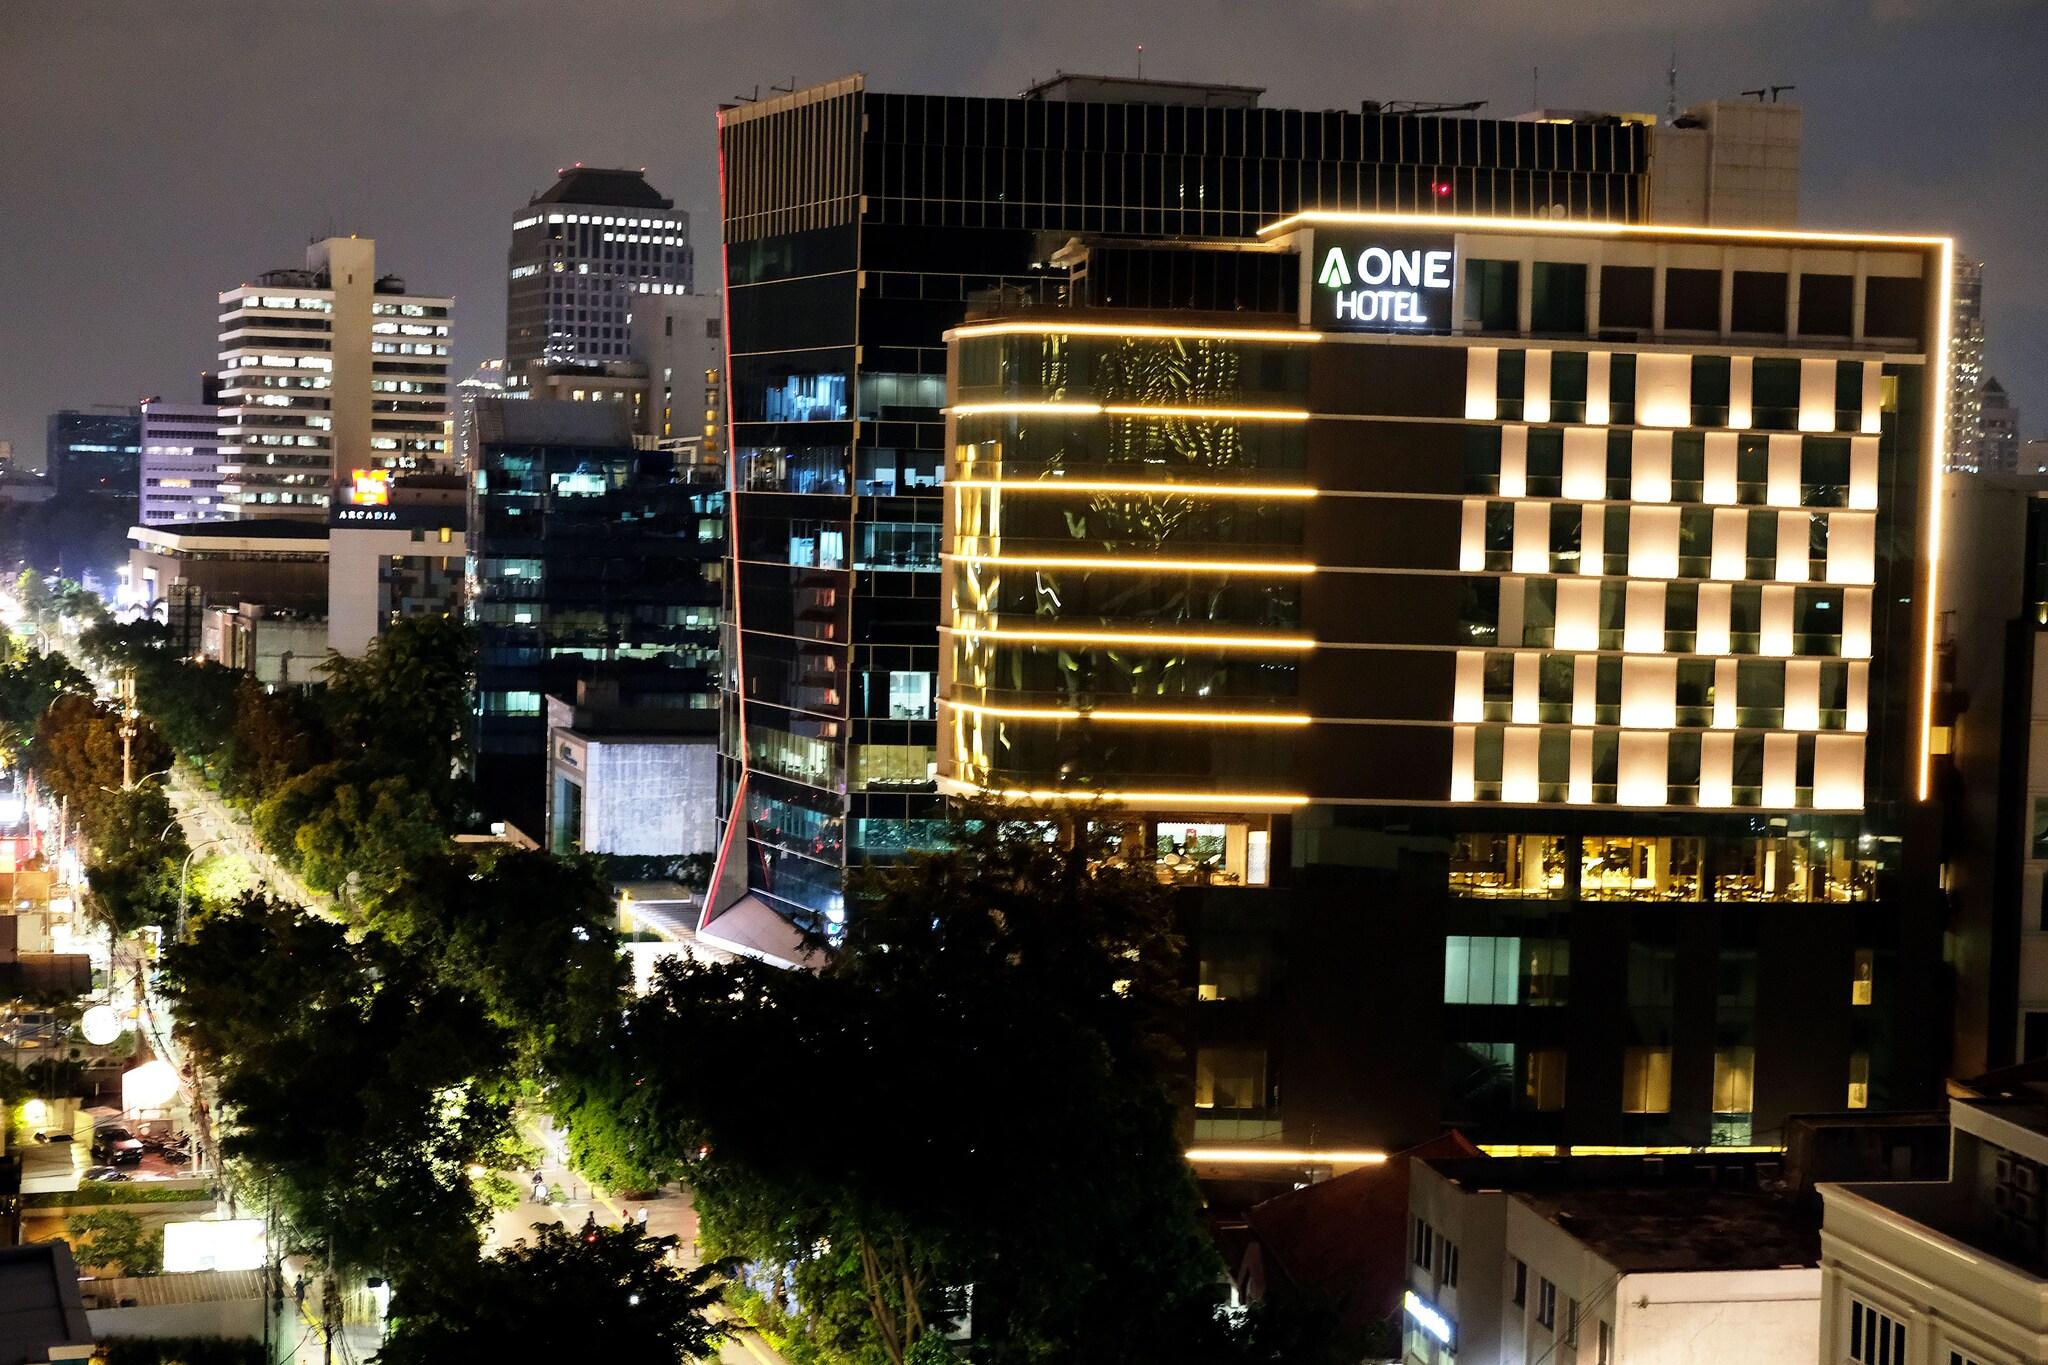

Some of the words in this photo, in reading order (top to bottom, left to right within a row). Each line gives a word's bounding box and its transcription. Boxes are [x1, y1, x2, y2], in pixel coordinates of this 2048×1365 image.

[1357, 247, 1452, 288] ONE
[1336, 290, 1428, 323] HOTEL
[338, 510, 397, 520] ARCADIA
